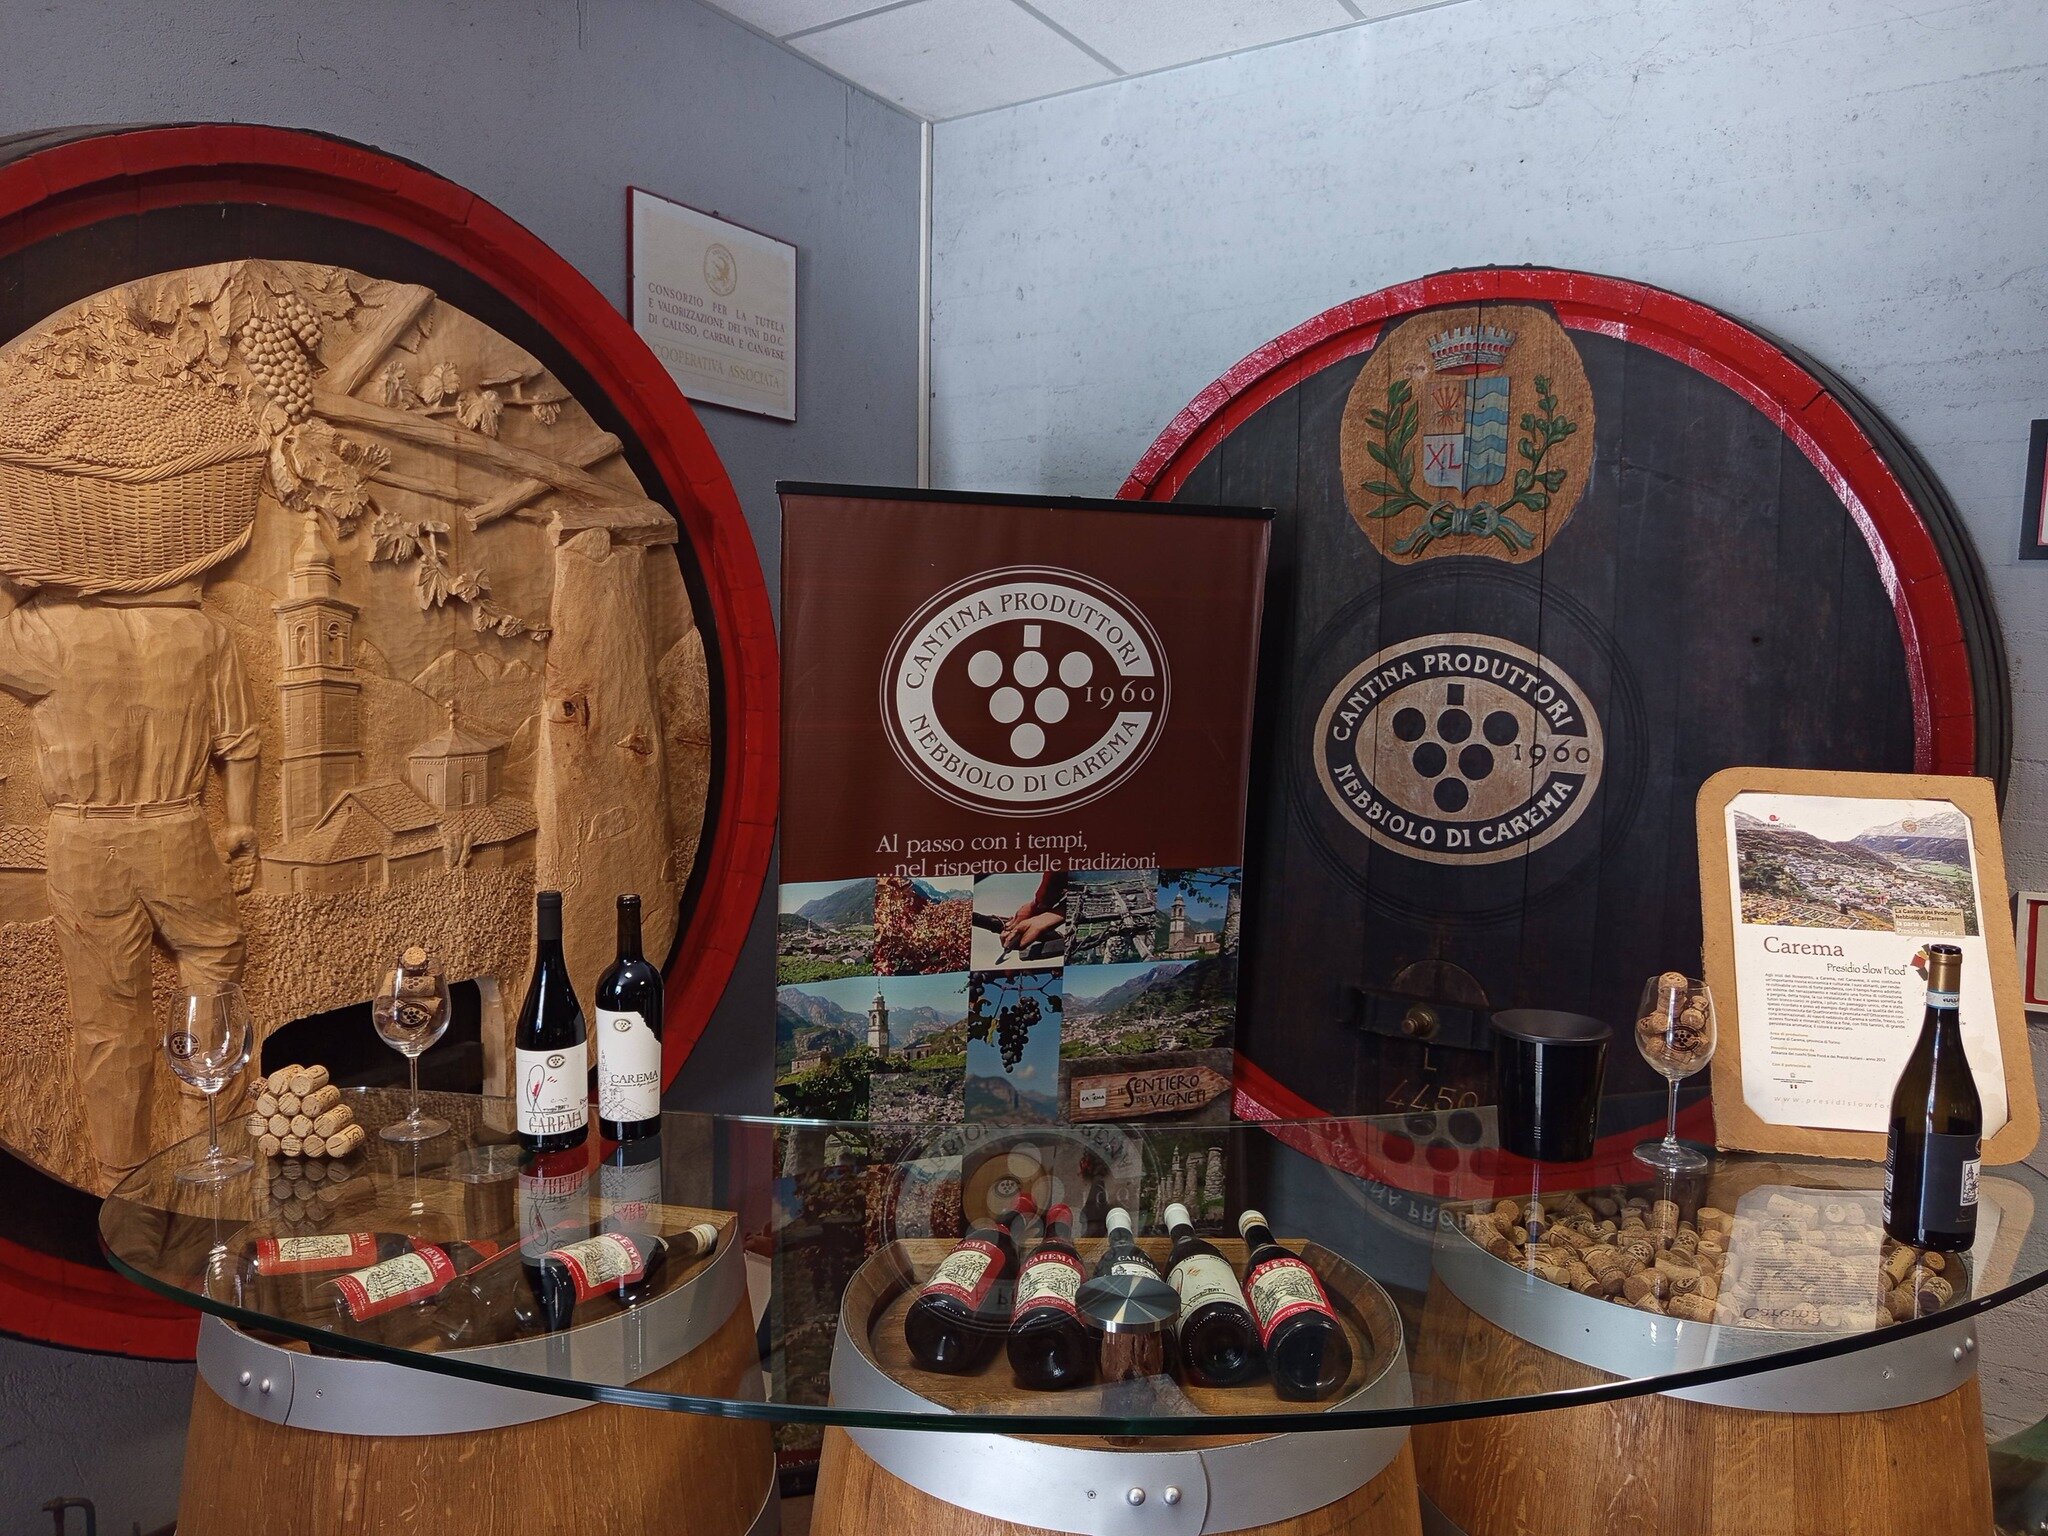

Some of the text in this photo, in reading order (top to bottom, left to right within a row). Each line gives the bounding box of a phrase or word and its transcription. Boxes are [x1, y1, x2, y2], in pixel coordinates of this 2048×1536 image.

[649, 283, 785, 333] CONSORZIO PER LA TUTELA
[649, 297, 653, 308] E
[658, 301, 724, 330] VALORIZZAZIONE
[728, 321, 741, 333] DEI
[648, 313, 658, 325] DI
[703, 330, 735, 347] CAREMA
[739, 339, 744, 349] E
[747, 342, 785, 361] CANAVESE
[653, 344, 780, 388] COOPERATIVA ASSOCIATA
[1425, 444, 1462, 470] XL
[906, 592, 1141, 689] CANTINA PRODUTTORI
[1085, 680, 1155, 709] 1960
[1332, 653, 1573, 741] CANTINA PRODUTTORI
[909, 713, 1138, 793] NEBBIOLO DI CAREMA
[1514, 739, 1590, 769] 1960
[1334, 763, 1574, 847] NEBBIOLO DI CAREMA
[875, 831, 1088, 856] Al passo con i tempi,
[934, 857, 1007, 877] rispetto
[1014, 854, 1061, 872] delle
[1068, 852, 1160, 870] tradizioni.
[1763, 936, 1844, 956] Carema
[1827, 962, 1860, 973] Presidio
[1862, 963, 1882, 974] Slow
[610, 1071, 659, 1084] CAREMA
[1124, 1075, 1199, 1108] SENTIERO
[1148, 1090, 1206, 1108] VIGNETI
[529, 1110, 583, 1134] CAREMA
[1025, 1253, 1074, 1268] CAREMA
